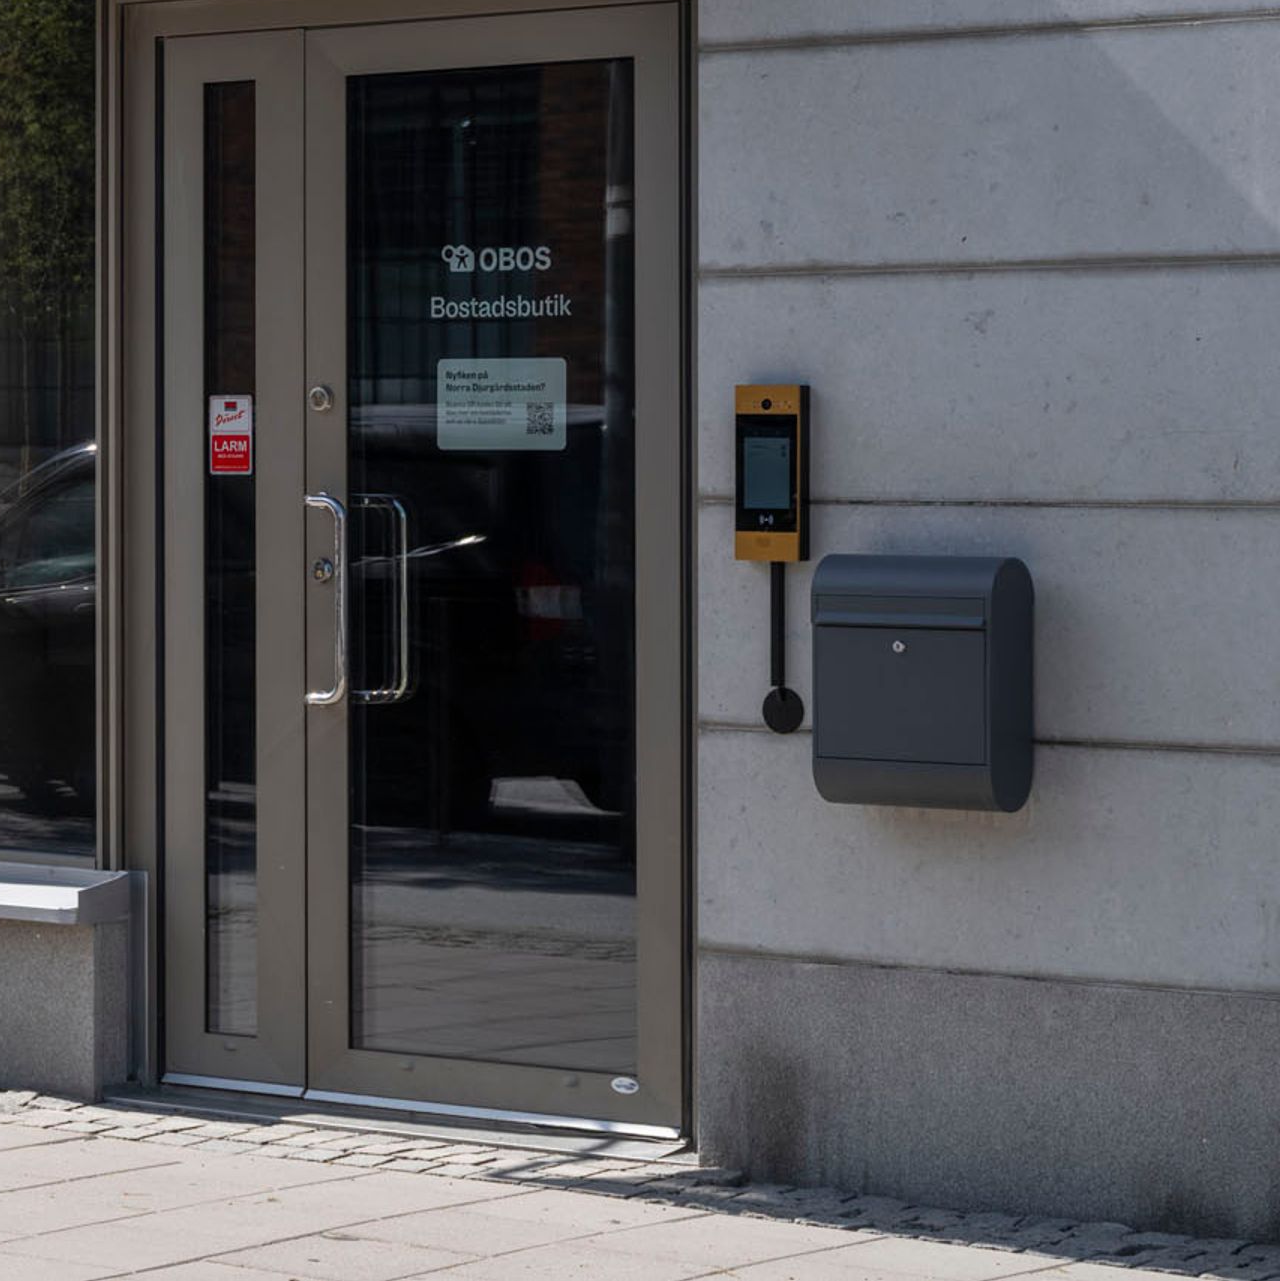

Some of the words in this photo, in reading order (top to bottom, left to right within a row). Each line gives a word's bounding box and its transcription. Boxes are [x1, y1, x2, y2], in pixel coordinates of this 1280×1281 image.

[479, 246, 552, 272] OBOS
[430, 294, 572, 318] Bostadsbutik
[214, 440, 247, 452] LARM
